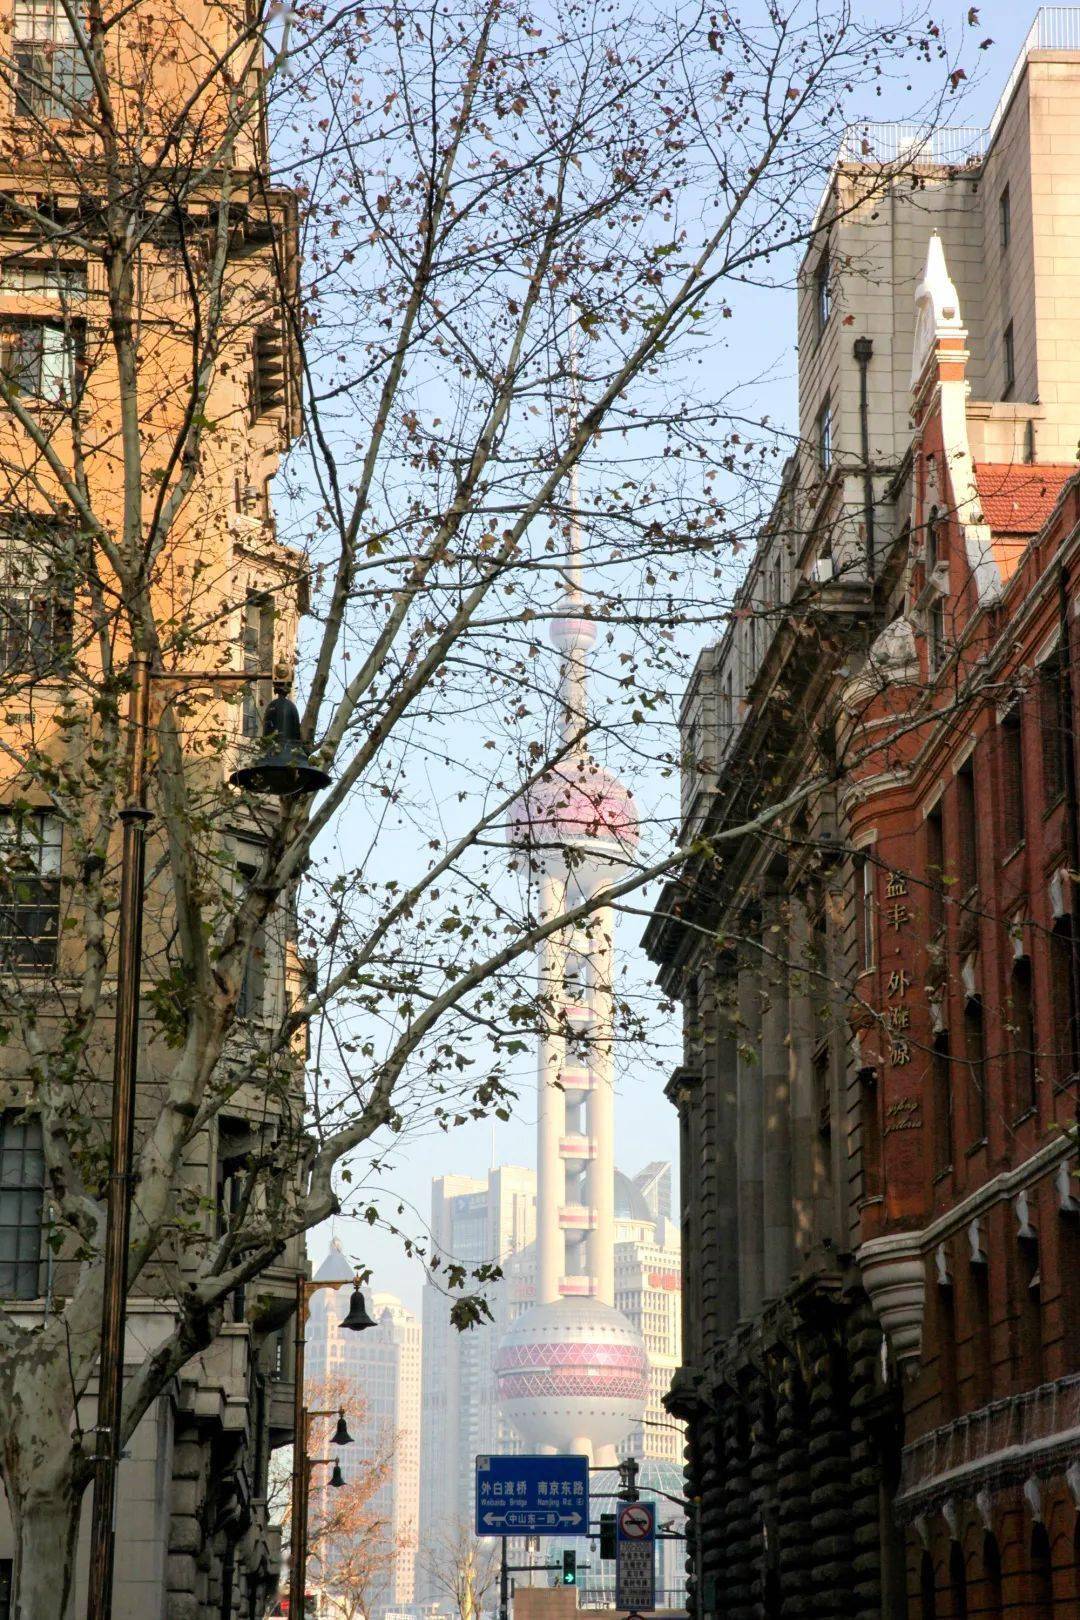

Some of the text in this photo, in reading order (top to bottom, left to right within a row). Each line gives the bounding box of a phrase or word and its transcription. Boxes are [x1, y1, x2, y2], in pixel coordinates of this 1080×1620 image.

[481, 1481, 527, 1496] 外白渡桥
[538, 1481, 584, 1496] 南京东路
[510, 1513, 556, 1524] 中山东一路
